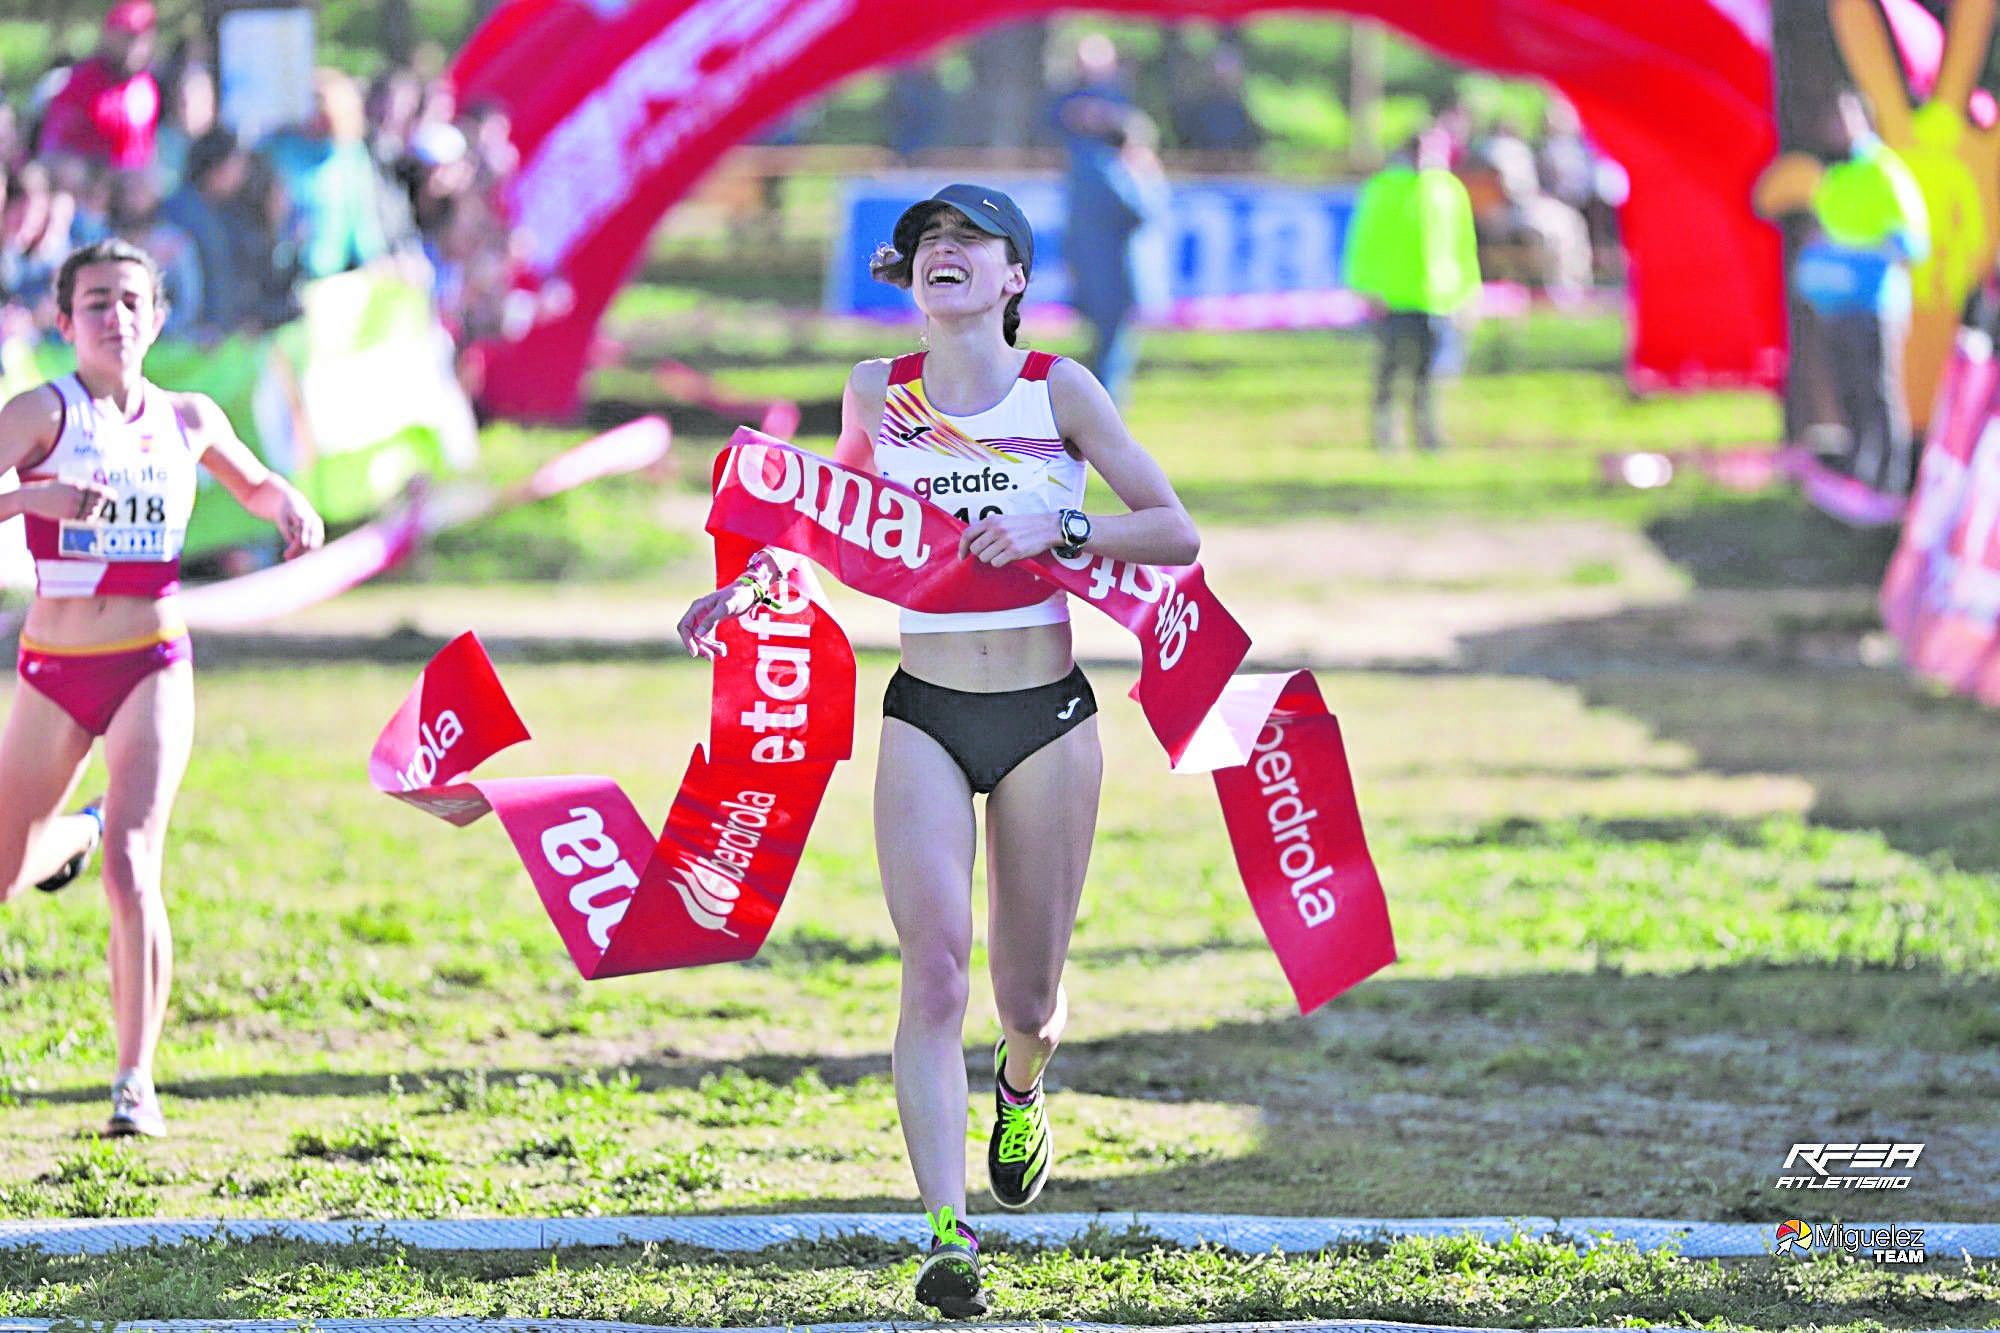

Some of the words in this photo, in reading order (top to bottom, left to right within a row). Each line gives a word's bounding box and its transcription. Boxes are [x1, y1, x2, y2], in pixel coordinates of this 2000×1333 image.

[88, 529, 168, 556] Jom
[100, 496, 166, 524] 418
[715, 444, 931, 570] oma
[1253, 714, 1336, 928] berdrola
